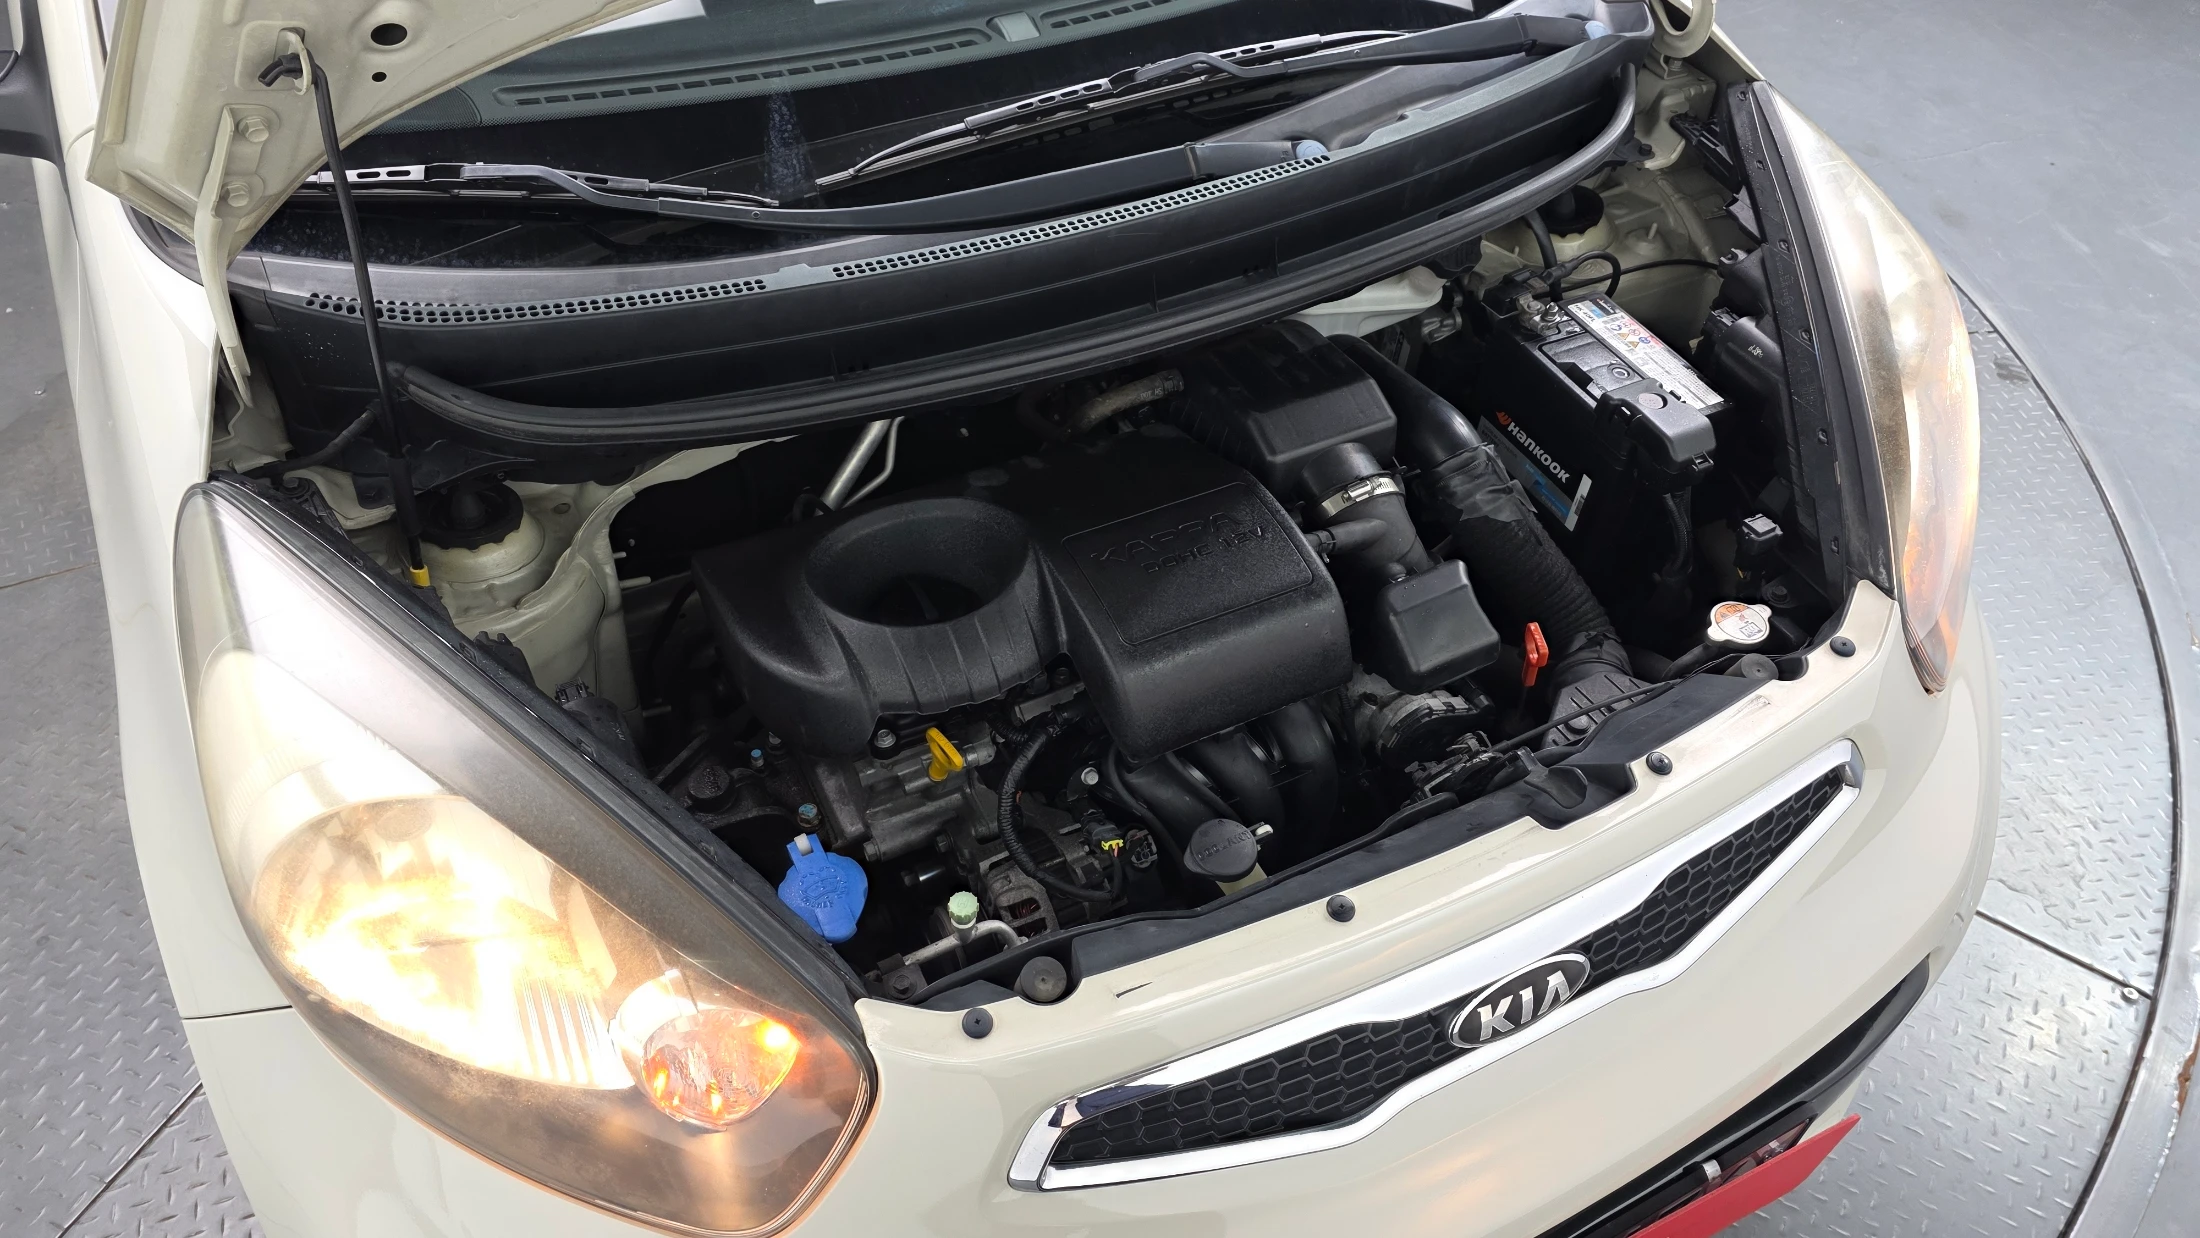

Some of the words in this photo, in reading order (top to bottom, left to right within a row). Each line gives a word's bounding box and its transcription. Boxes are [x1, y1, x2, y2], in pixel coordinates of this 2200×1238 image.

[1090, 511, 1245, 562] KAPPA
[1140, 543, 1214, 573] DOHC
[1218, 525, 1263, 549] 12V
[1476, 970, 1571, 1042] KIA
